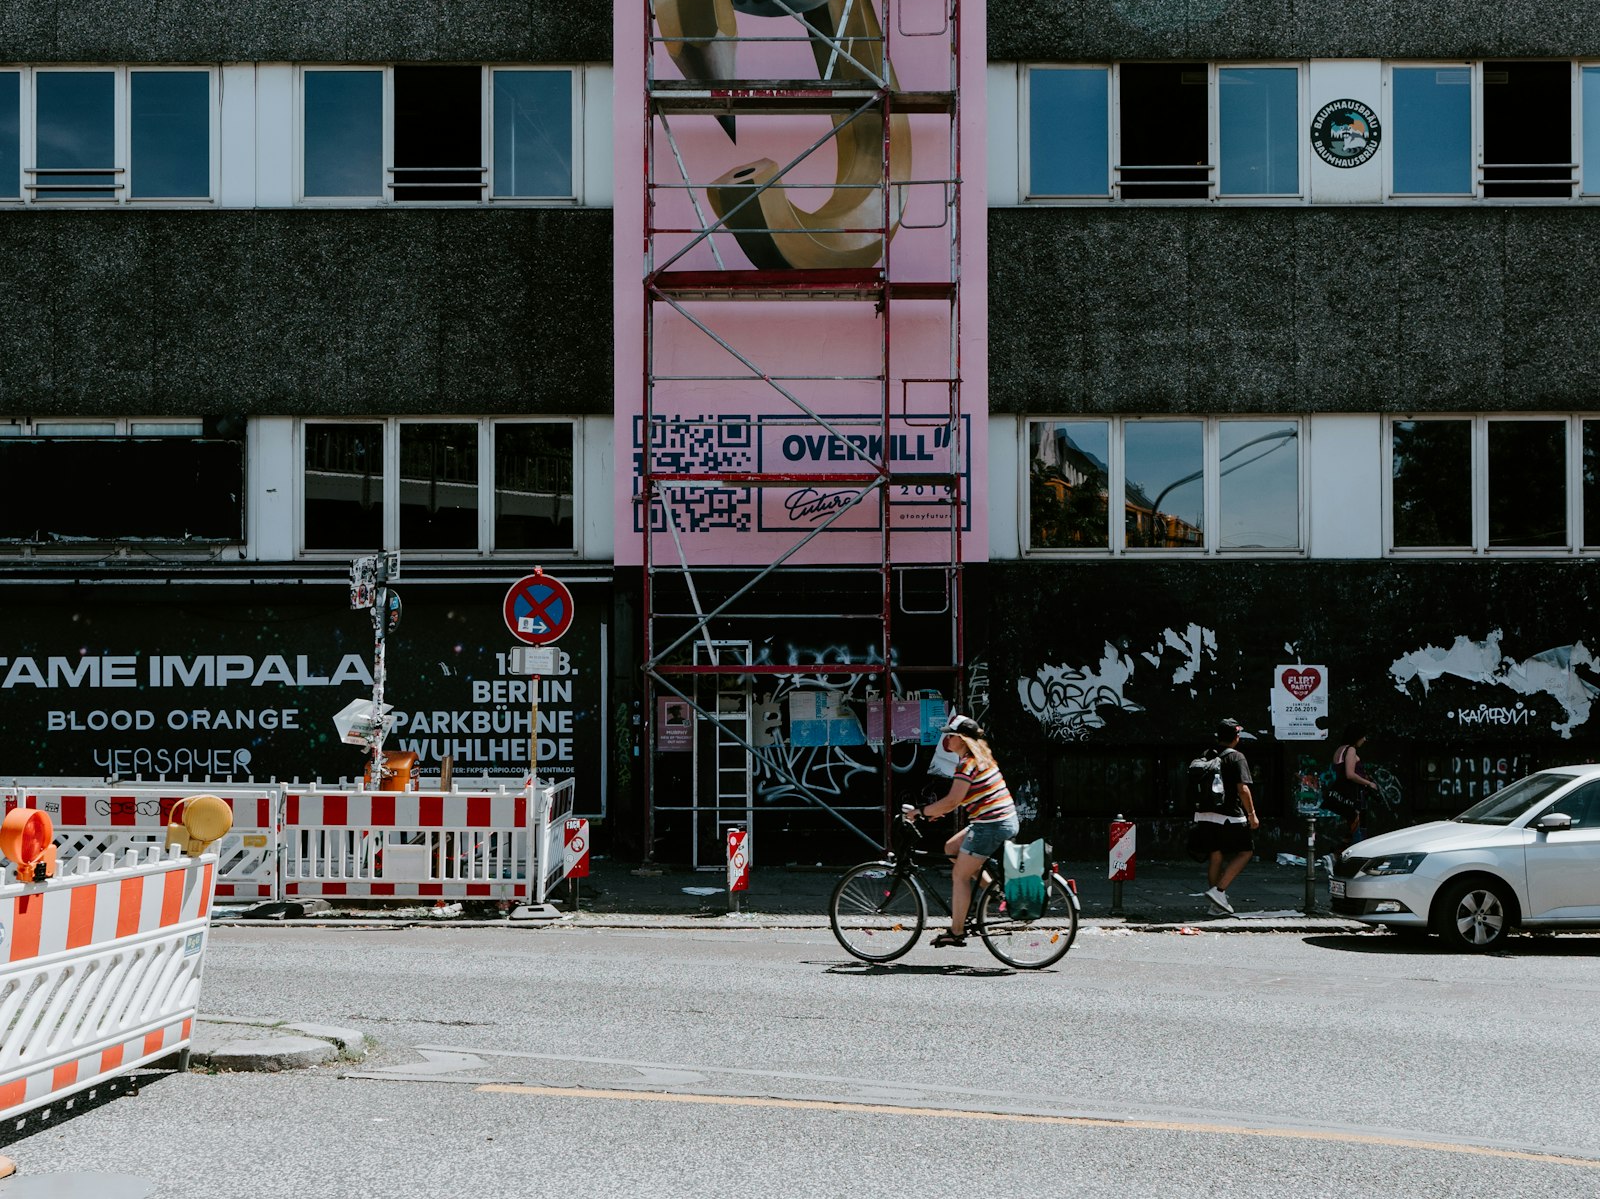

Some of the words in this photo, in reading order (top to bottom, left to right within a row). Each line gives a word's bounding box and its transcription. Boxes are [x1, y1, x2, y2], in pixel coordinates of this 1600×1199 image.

[1314, 101, 1378, 129] BAUMHAUSBRÄU
[1314, 139, 1378, 167] BAUMHAUSBRÄU
[900, 485, 950, 495] 2019
[150, 654, 375, 687] IMPALA
[1288, 676, 1315, 685] FLIRT
[472, 680, 572, 704] BERLIN
[48, 710, 156, 731] BLOOD
[167, 709, 300, 731] ORANGE
[390, 705, 574, 734] PARKBÜHNE
[399, 738, 574, 761] WUHLHEIDE
